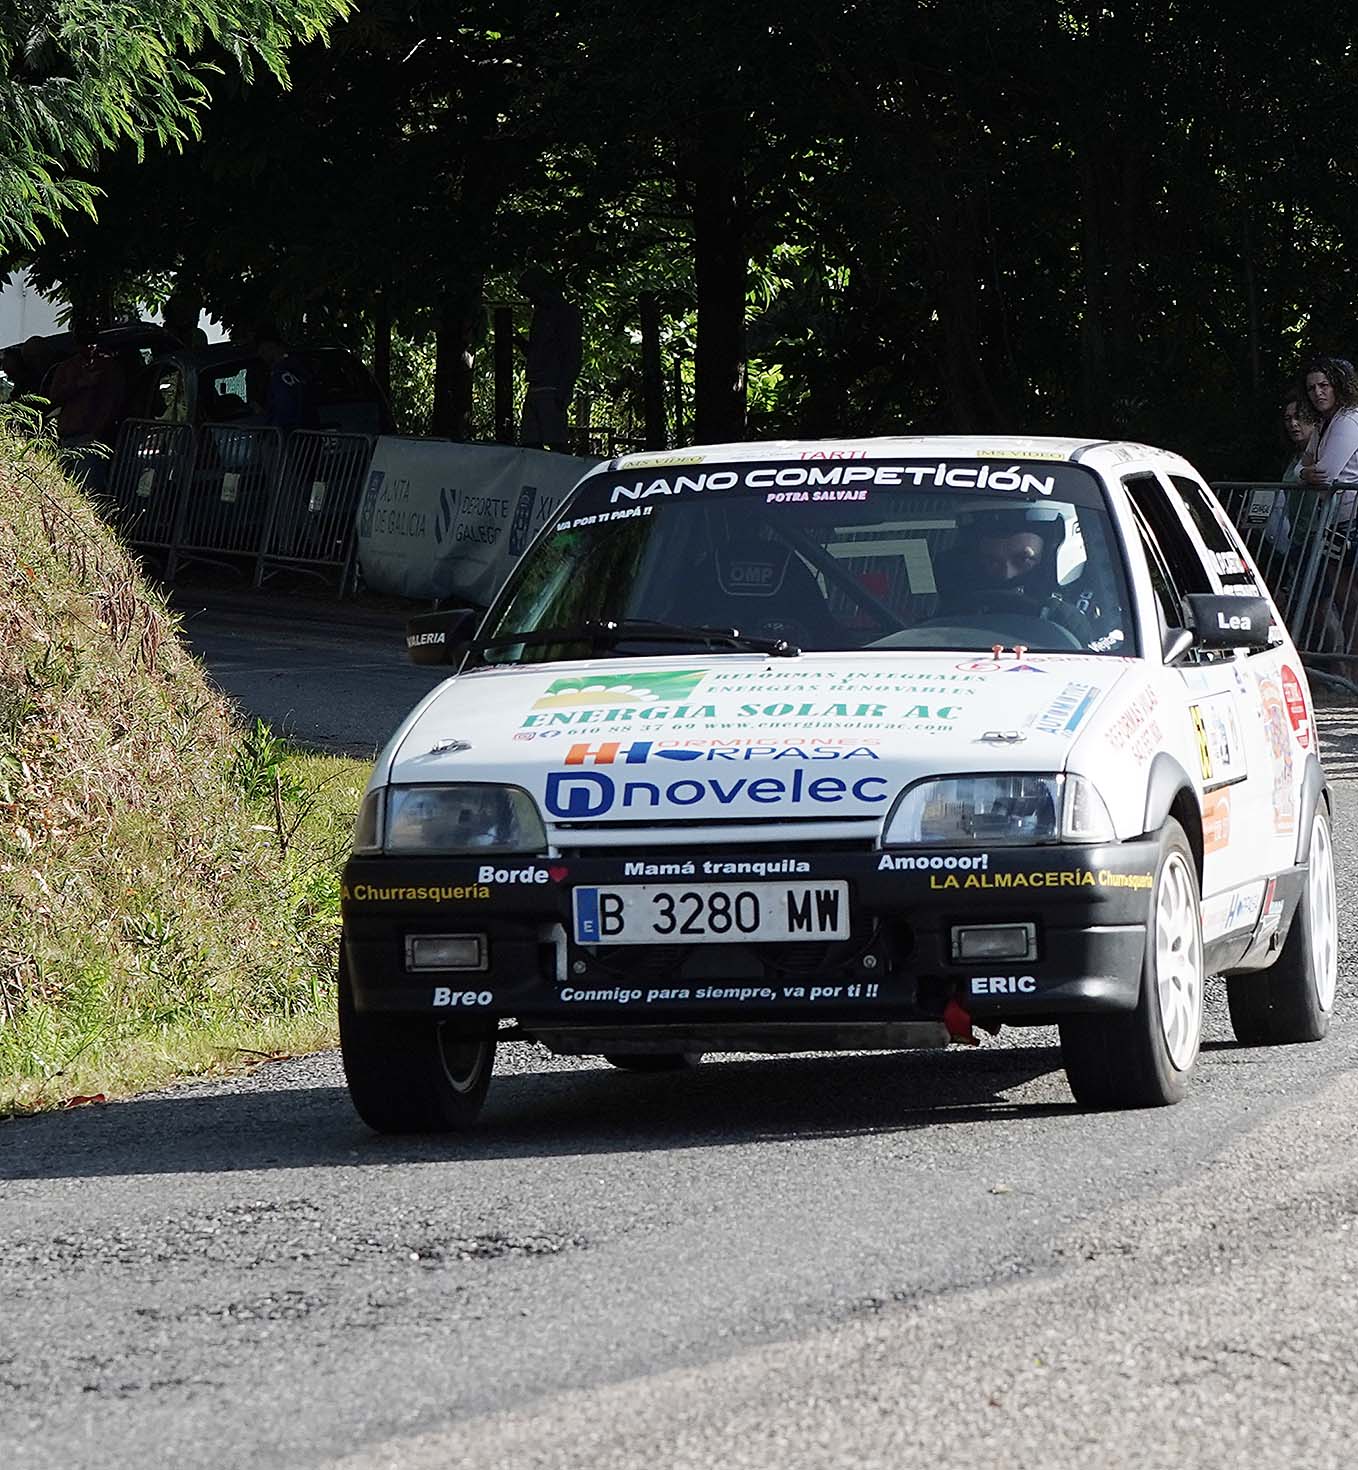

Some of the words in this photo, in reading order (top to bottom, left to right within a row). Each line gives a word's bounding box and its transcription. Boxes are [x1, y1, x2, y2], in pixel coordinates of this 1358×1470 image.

[610, 472, 739, 503] NANO
[766, 491, 810, 503] POTRA
[813, 490, 867, 502] SALVAJE
[462, 495, 509, 519] DEPORTE
[557, 520, 571, 531] VA
[573, 515, 597, 528] POR
[598, 512, 610, 523] TI
[611, 506, 642, 521] PAPÁ
[730, 566, 773, 584] OMP
[1217, 612, 1251, 631] Lea
[715, 671, 836, 681] REFORMAS
[841, 671, 987, 683] INTEGRALES
[830, 684, 976, 696] RENOVABLES
[519, 705, 717, 728] ENERGIA
[737, 702, 889, 719] SOLAR
[903, 705, 963, 720] AC
[624, 768, 888, 806] novelec
[624, 861, 695, 876] Mamá
[703, 859, 810, 876] tranquila
[878, 854, 989, 870] Amoooor!
[478, 866, 549, 884] Borde
[930, 875, 959, 889] LA
[964, 868, 1096, 888] ALMACERÍA
[354, 883, 490, 903] Churrasquería
[600, 893, 624, 935] B
[652, 891, 760, 934] 3280
[787, 889, 840, 932] MW
[584, 920, 594, 932] E
[560, 986, 642, 1003] Conmigo
[647, 988, 690, 1002] para
[696, 983, 776, 1001] siempre,
[783, 987, 804, 998] va
[809, 987, 843, 1001] por
[847, 984, 861, 998] ti
[866, 983, 879, 998] !!
[971, 976, 1038, 994] ERIC
[433, 987, 493, 1006] Breo
